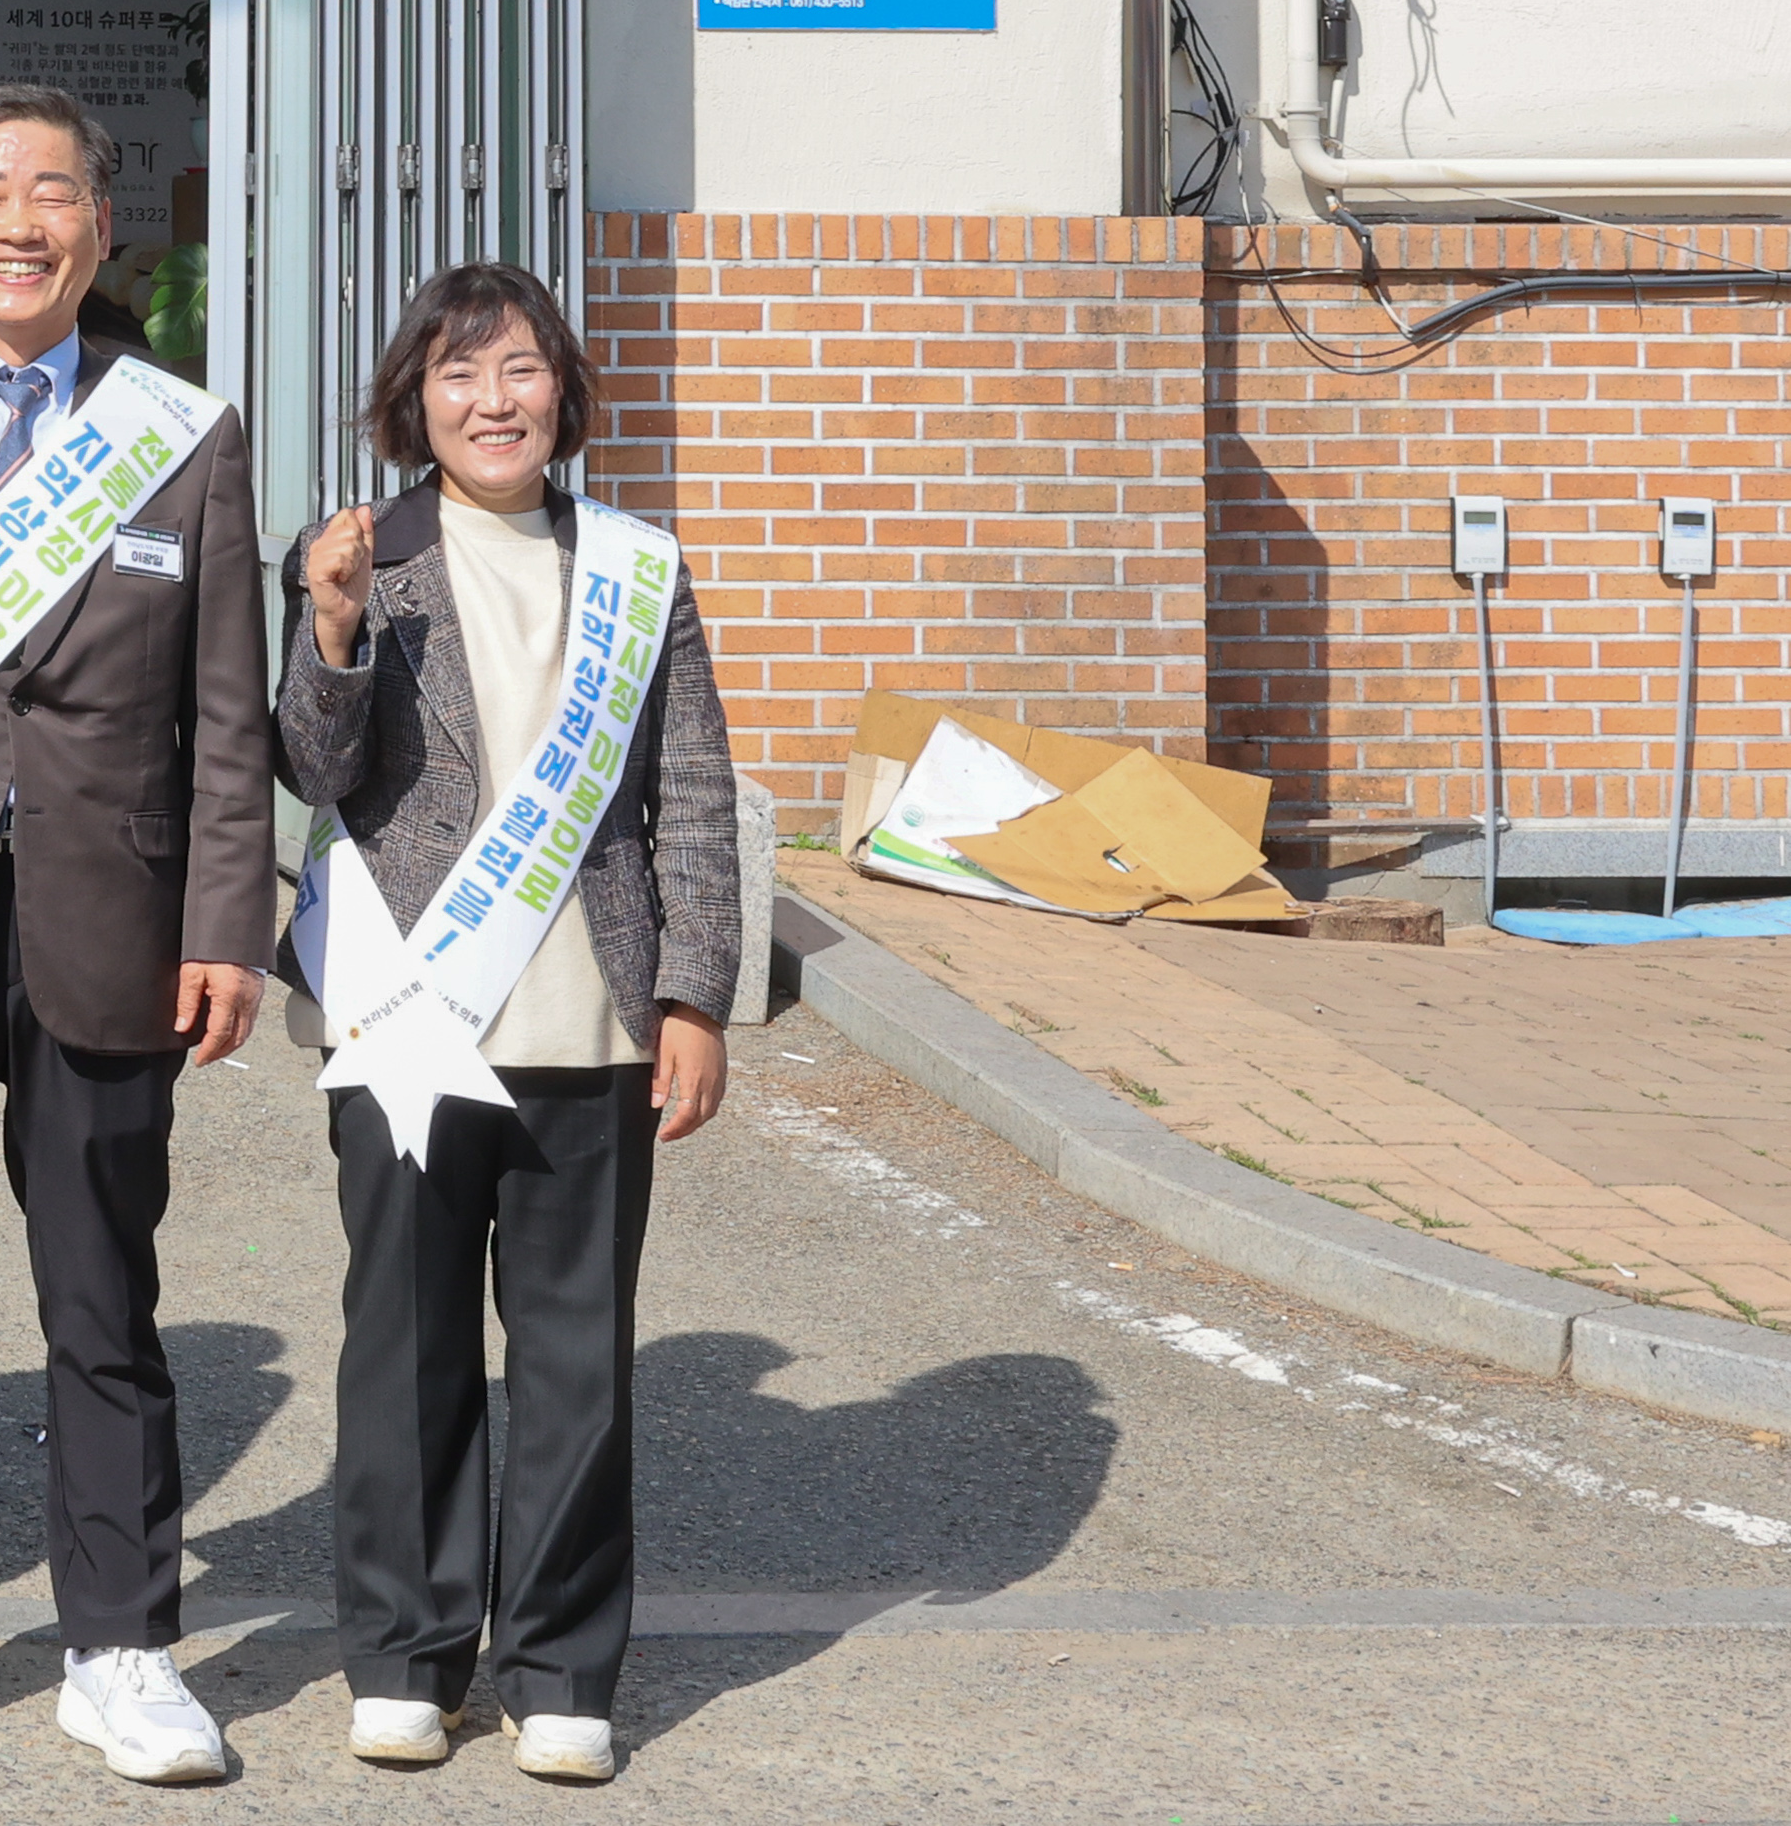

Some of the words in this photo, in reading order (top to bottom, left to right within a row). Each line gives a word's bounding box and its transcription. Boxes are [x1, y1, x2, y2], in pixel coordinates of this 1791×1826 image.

[7, 10, 44, 29] 세계
[50, 11, 93, 29] 10대
[34, 424, 175, 579] 전통시장
[533, 569, 622, 795] 지역상권에
[605, 546, 669, 725] 전통시장
[423, 792, 549, 964] 활력을!
[511, 726, 625, 916] 이용으로
[359, 980, 424, 1032] 전라남도의회
